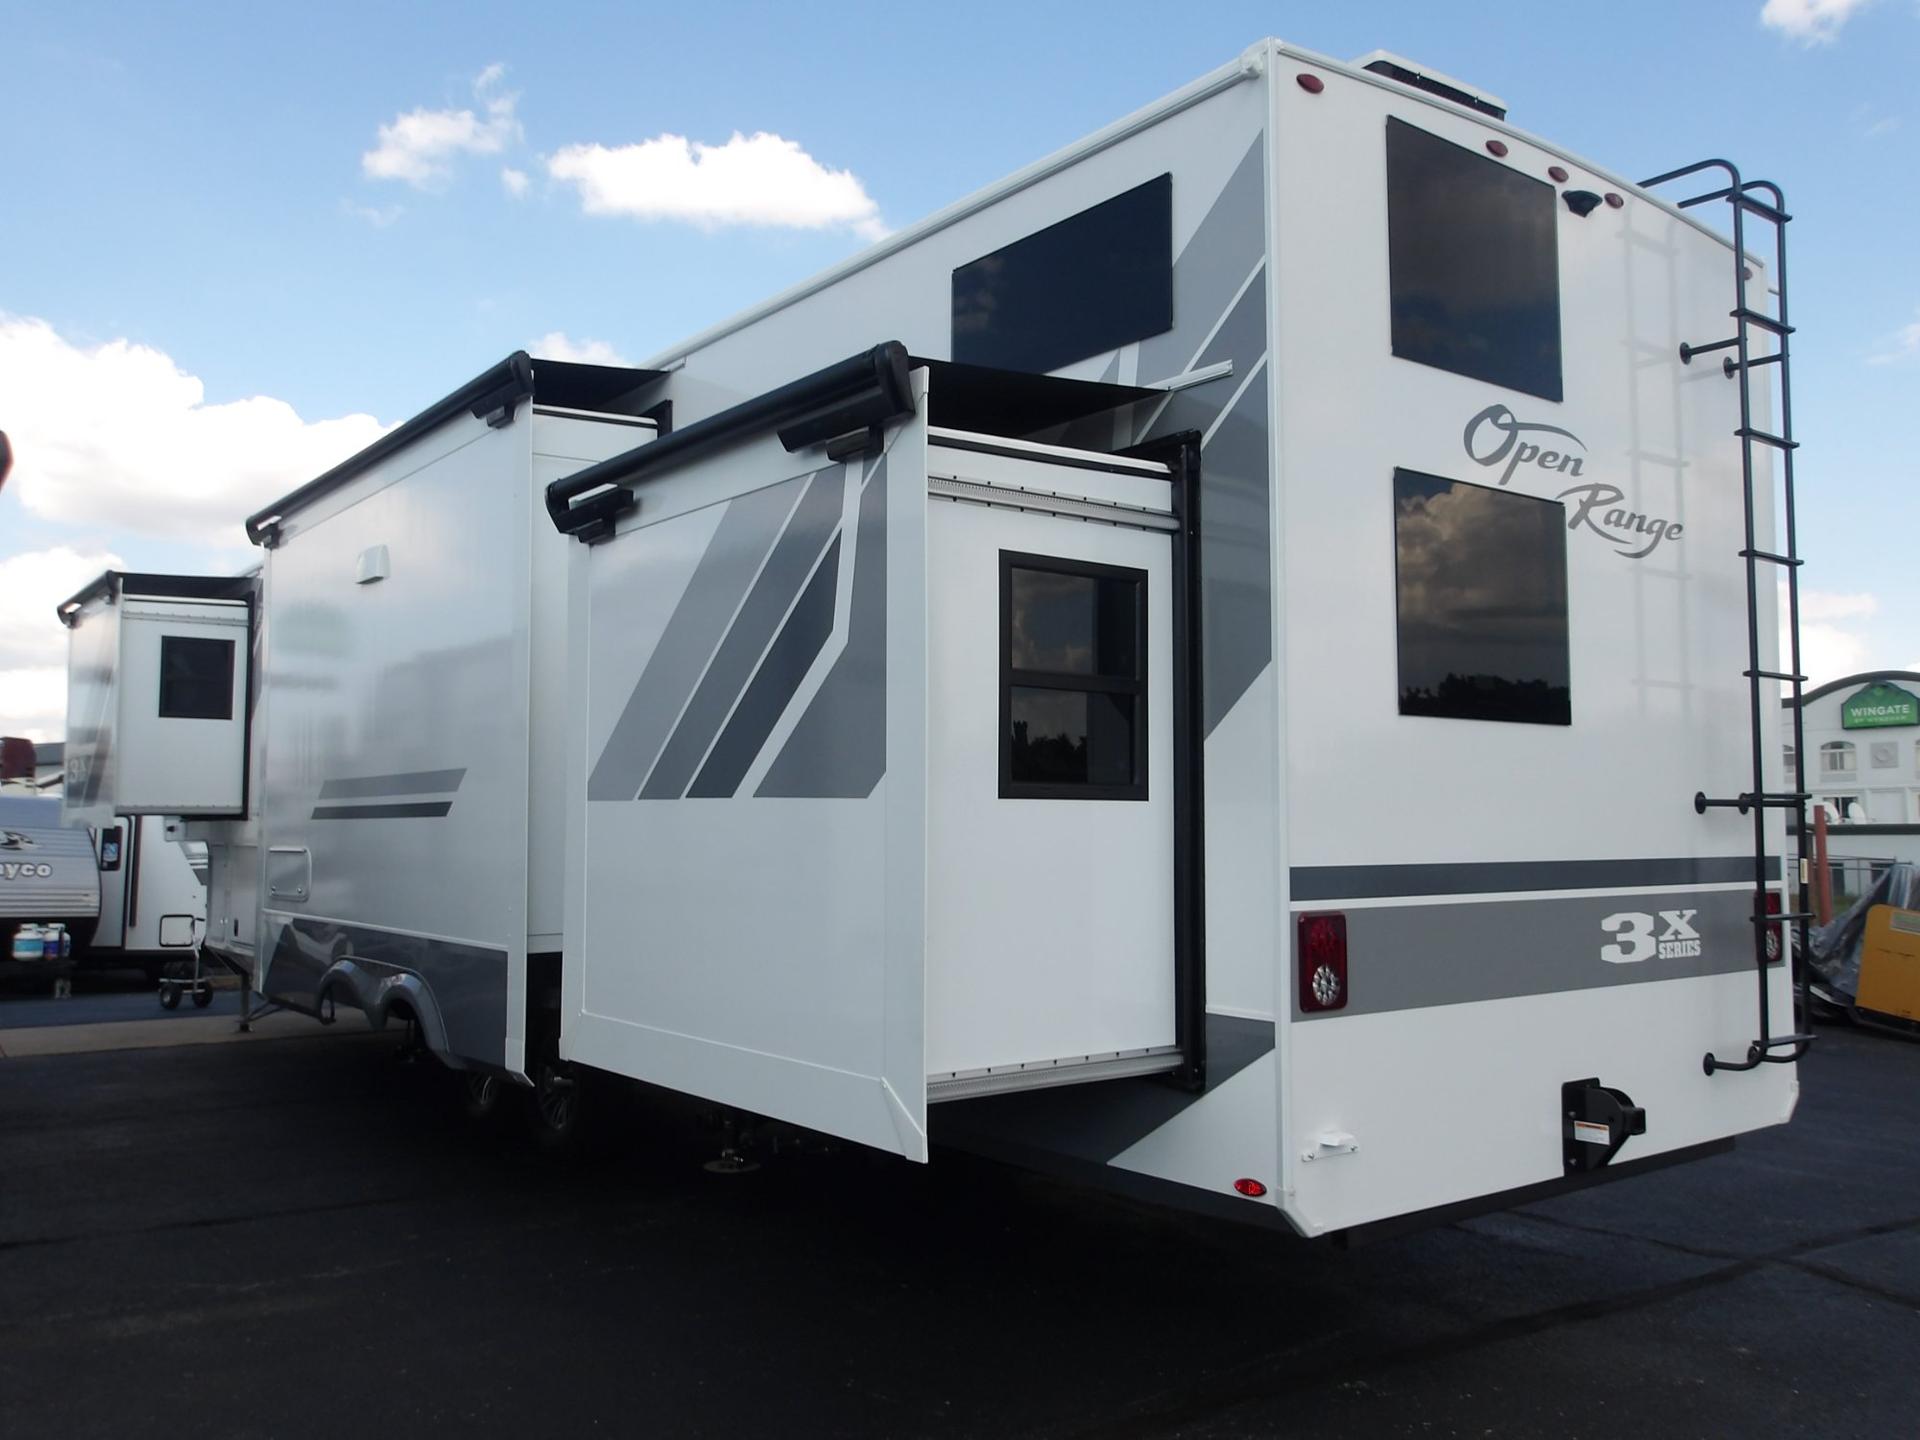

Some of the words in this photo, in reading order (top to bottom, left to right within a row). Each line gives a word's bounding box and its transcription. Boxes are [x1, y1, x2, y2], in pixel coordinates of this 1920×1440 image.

[1463, 403, 1588, 486] Open
[1555, 482, 1684, 559] Range
[1850, 703, 1910, 717] WINGATE
[1658, 939, 1701, 960] SERIES
